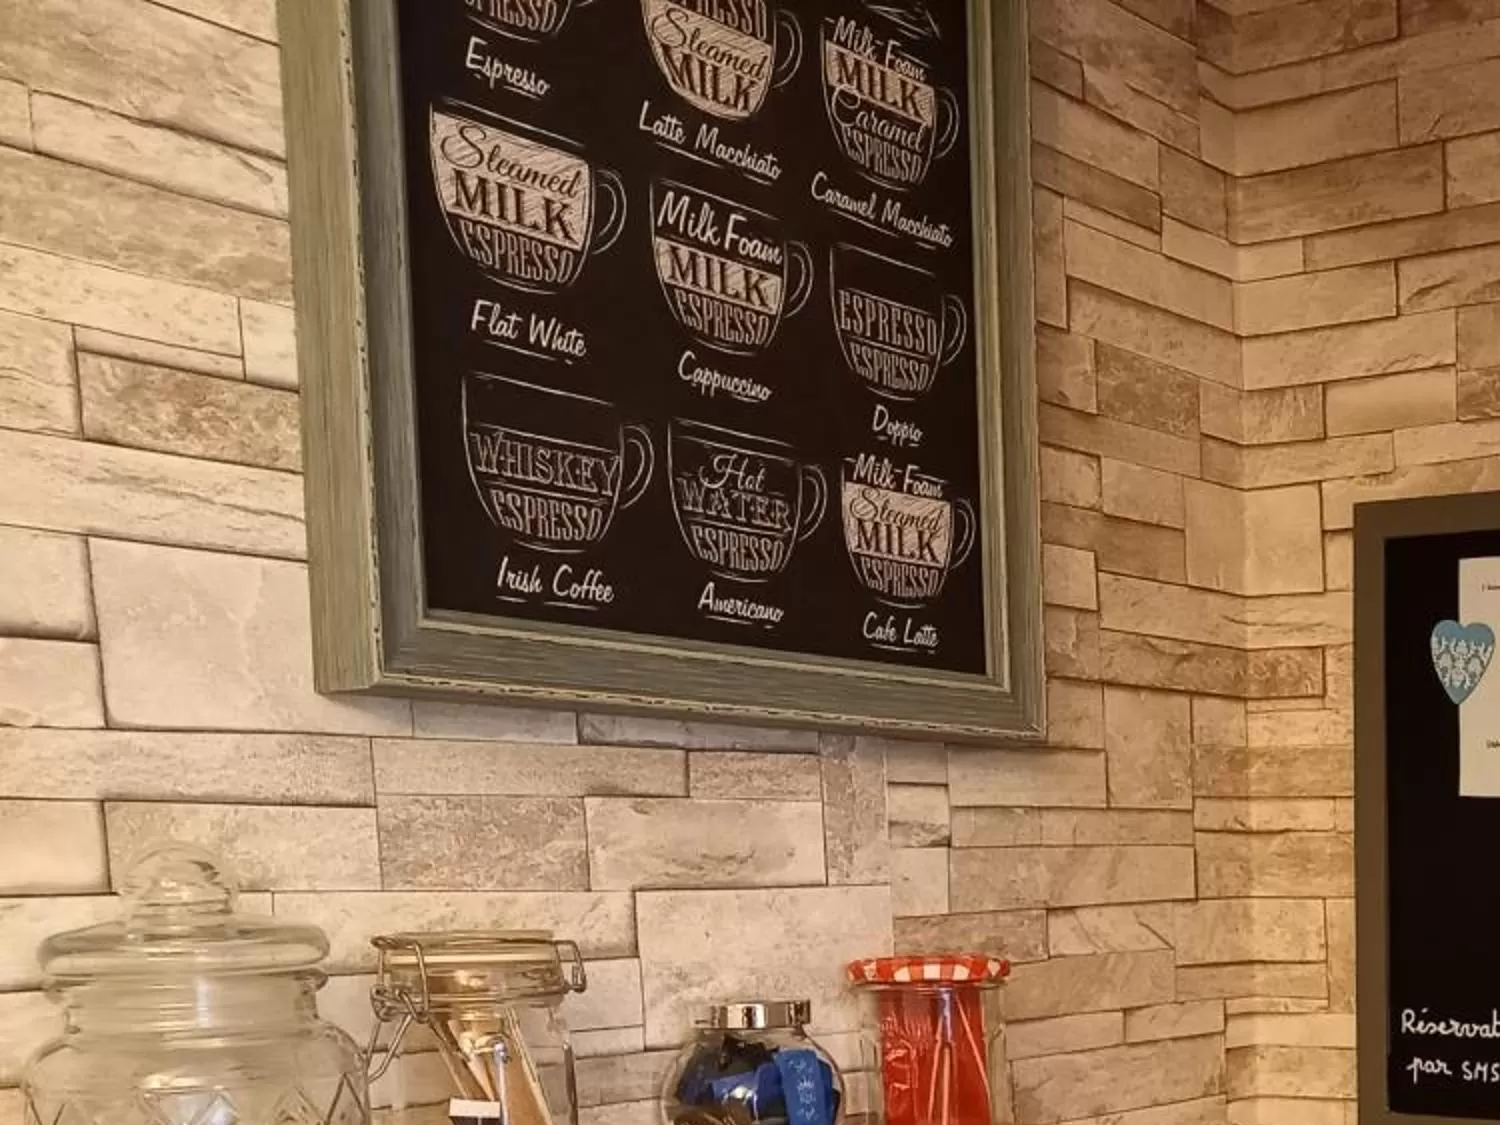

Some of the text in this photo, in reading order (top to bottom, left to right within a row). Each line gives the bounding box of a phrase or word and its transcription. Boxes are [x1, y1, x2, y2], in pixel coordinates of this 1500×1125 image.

[466, 36, 551, 95] Espresso
[652, 8, 768, 78] Steamed
[662, 46, 756, 111] MILK
[837, 51, 924, 122] MILK
[639, 101, 782, 179] Latte Macchiato
[831, 83, 926, 152] Caramel
[441, 124, 582, 198] Steamed
[842, 124, 923, 184] ESPRESSO
[452, 168, 579, 244] MILK
[657, 191, 782, 264] Milk Foam
[811, 172, 952, 247] Caramel Macchiato
[460, 219, 574, 284] ESPRESSO
[669, 245, 772, 308] MILK
[471, 299, 587, 356] Flat White
[674, 288, 769, 344] ESPRESSO
[838, 289, 937, 356] ESPRESSO
[678, 350, 773, 400] Cappuccino
[850, 342, 929, 391] ESPRESSO
[872, 404, 923, 447] Doppio
[470, 431, 620, 496] WHISKEY
[699, 454, 767, 492] Hot
[853, 453, 943, 498] Milk Foam
[490, 489, 602, 541] ESPRESSO
[676, 477, 792, 532] WATER
[850, 488, 943, 532] Steamed
[690, 525, 784, 571] ESPRESSO
[856, 519, 938, 562] MILK
[497, 556, 615, 602] Irish Coffee
[698, 581, 784, 622] Americano
[861, 556, 939, 597] ESPRESSO
[863, 611, 939, 647] Cafe Latte
[1406, 1057, 1452, 1084] par
[1462, 1062, 1500, 1082] SMS
